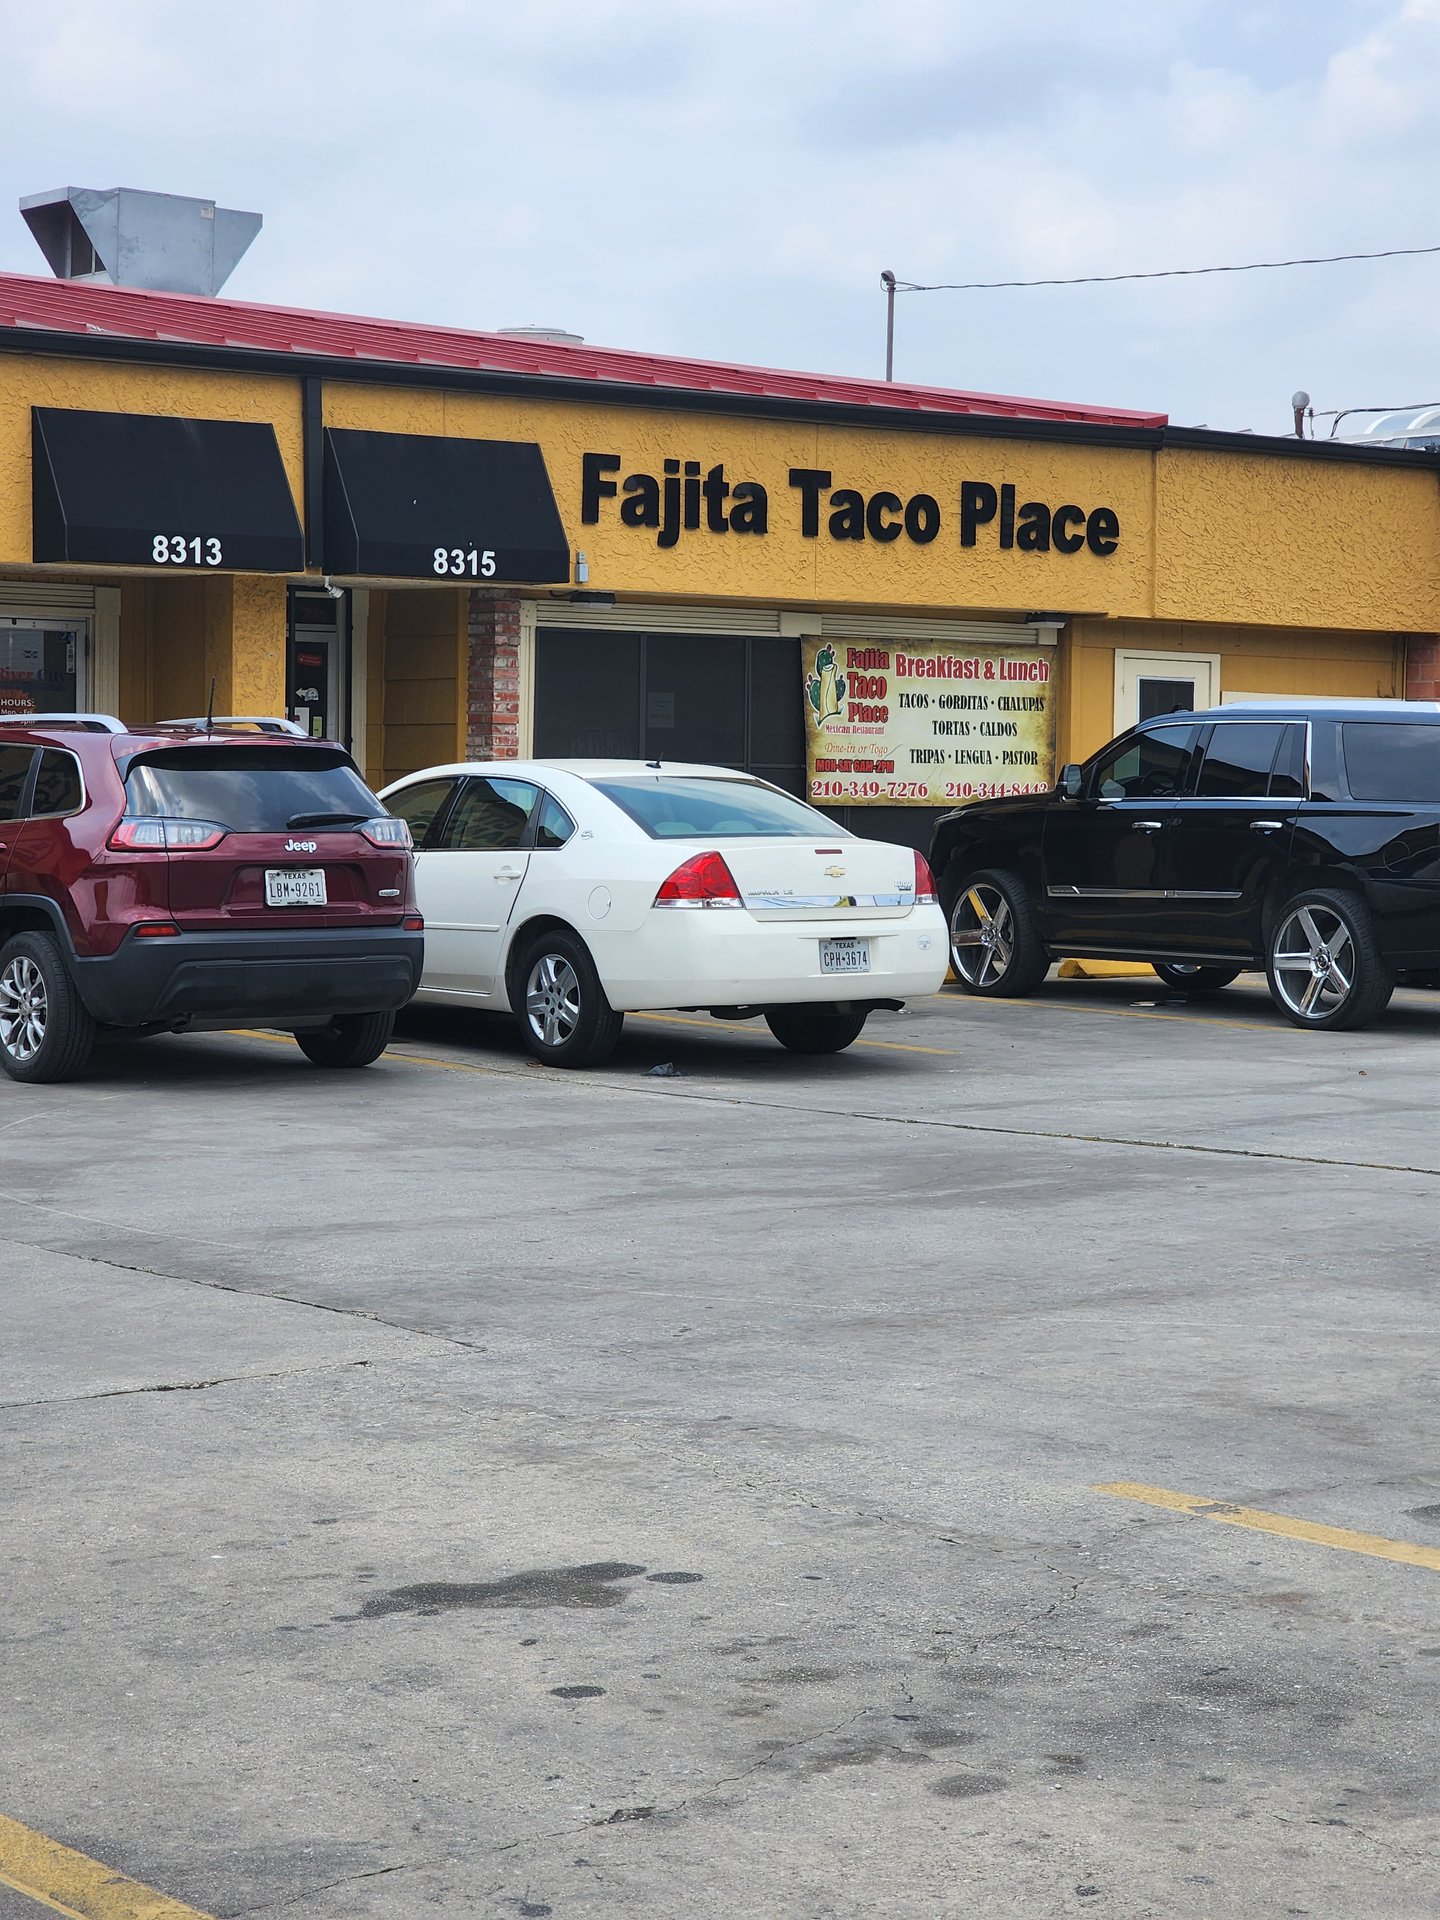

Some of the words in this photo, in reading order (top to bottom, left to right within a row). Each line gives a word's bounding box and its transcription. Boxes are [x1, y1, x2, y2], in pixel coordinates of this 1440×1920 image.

[581, 452, 768, 548] Fajita
[789, 468, 941, 544] Taco
[960, 481, 1120, 556] Place
[152, 535, 223, 566] 8313
[433, 548, 496, 577] 8315
[847, 648, 890, 670] Fajita
[896, 654, 980, 680] Breakfast
[983, 661, 995, 680] &
[999, 657, 1049, 682] Lunch
[847, 672, 887, 700] Taco
[1, 698, 35, 707] HOURS:
[899, 693, 929, 709] TACOS
[939, 694, 988, 711] GORDITAS
[997, 696, 1045, 712] CHALUPAS
[848, 702, 889, 724] Place
[825, 724, 850, 734] Mexican
[852, 725, 884, 735] Restaurant
[932, 720, 970, 736] TORTAS
[980, 721, 1018, 737] CALDOS
[825, 742, 855, 753] Dine-in
[816, 758, 852, 772] MON-SAT
[853, 759, 894, 773] 6AM-2PM
[910, 749, 945, 764] TRIPAS
[955, 749, 992, 765] LENGUA
[1002, 750, 1038, 766] PASTOR
[811, 781, 928, 798] 210-349-7276
[285, 839, 317, 854] Jeep
